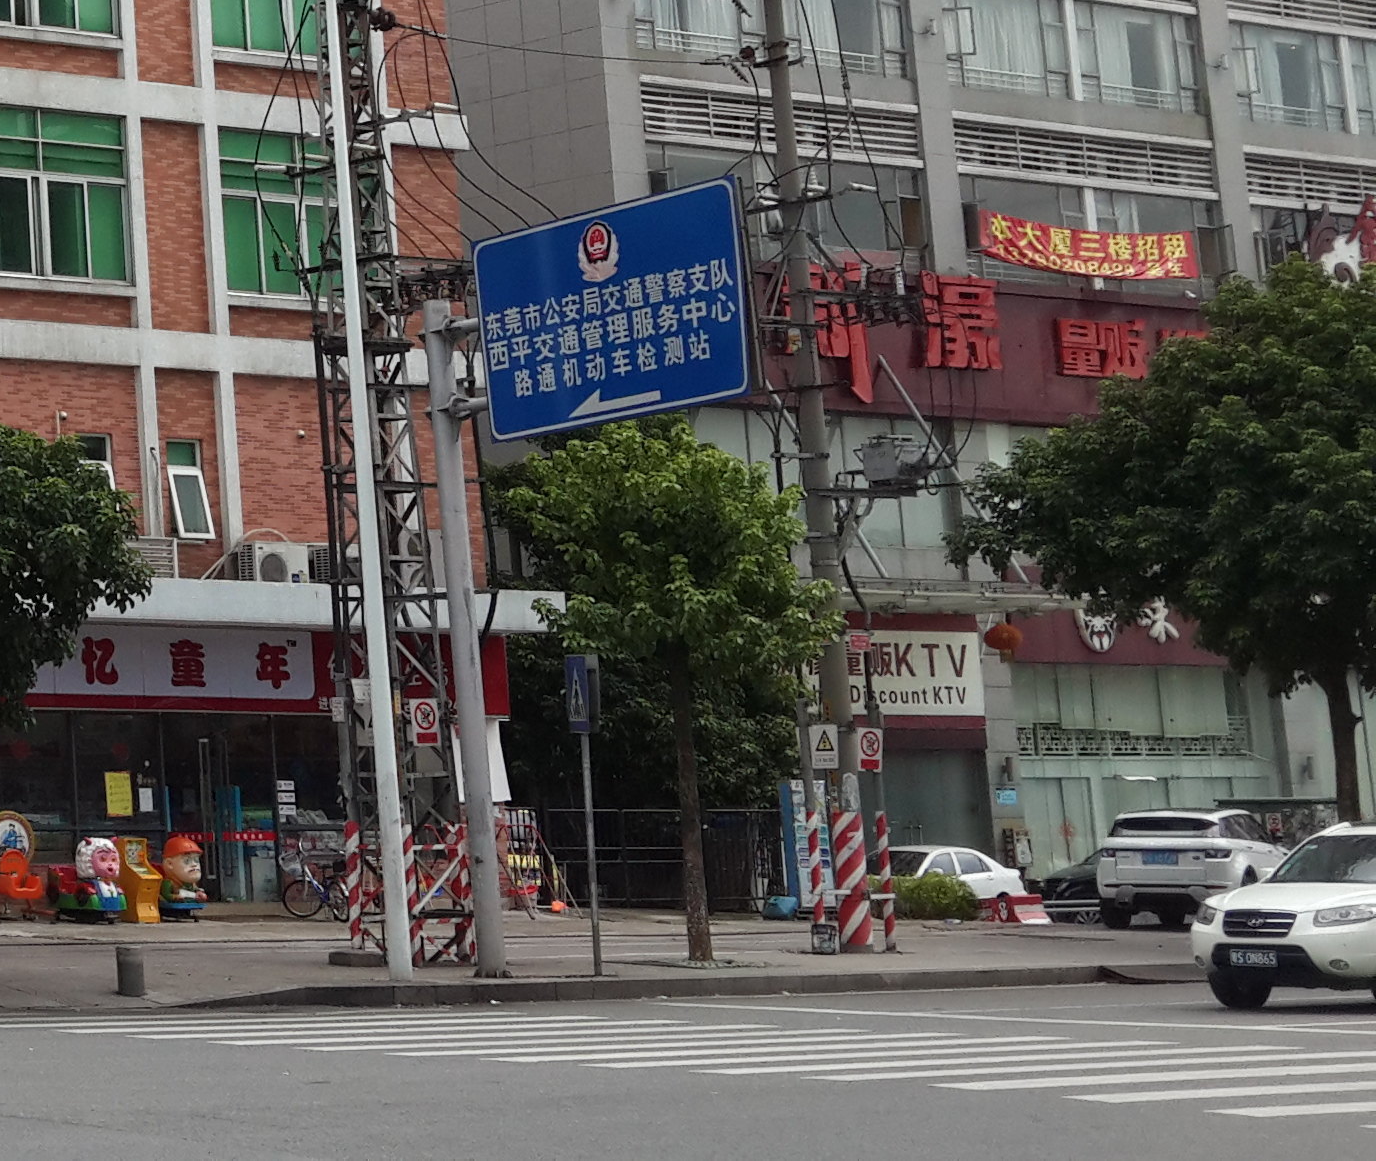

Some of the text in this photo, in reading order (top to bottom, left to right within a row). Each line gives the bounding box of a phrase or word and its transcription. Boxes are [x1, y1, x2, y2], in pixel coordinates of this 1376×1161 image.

[485, 258, 733, 340] 东莞市公安局交通警察支队
[488, 292, 736, 372] 西平交通管理服务中心
[514, 329, 711, 398] 路通机动车检测站
[81, 636, 291, 689] 忆童年
[933, 687, 966, 705] KTV
